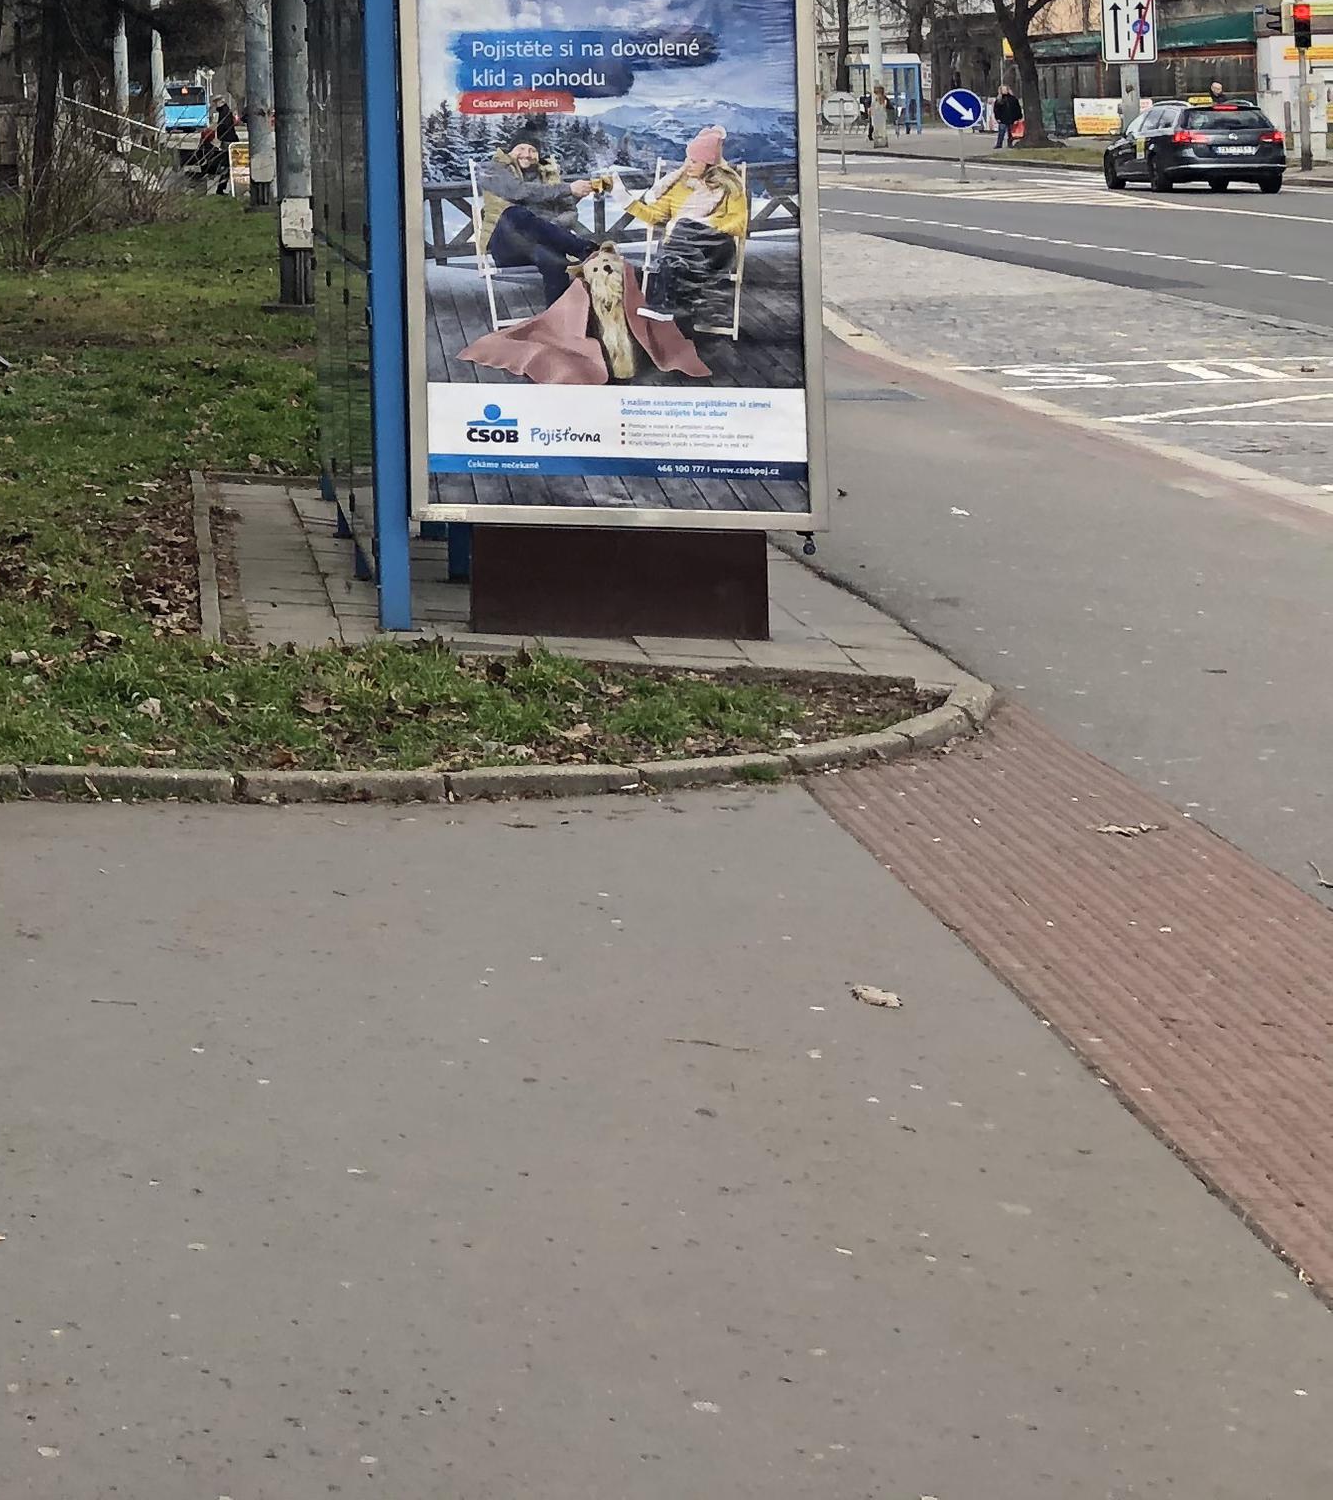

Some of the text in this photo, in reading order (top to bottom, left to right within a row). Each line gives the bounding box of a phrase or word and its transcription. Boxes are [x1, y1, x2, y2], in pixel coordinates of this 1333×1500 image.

[472, 38, 700, 61] Pojistěte si na dovolené
[472, 69, 606, 91] klid a pohodu
[472, 97, 559, 110] Cestovní pojištění
[467, 426, 601, 446] ČSOB Pojišťovna
[674, 465, 690, 474] 100
[691, 465, 705, 474] 777
